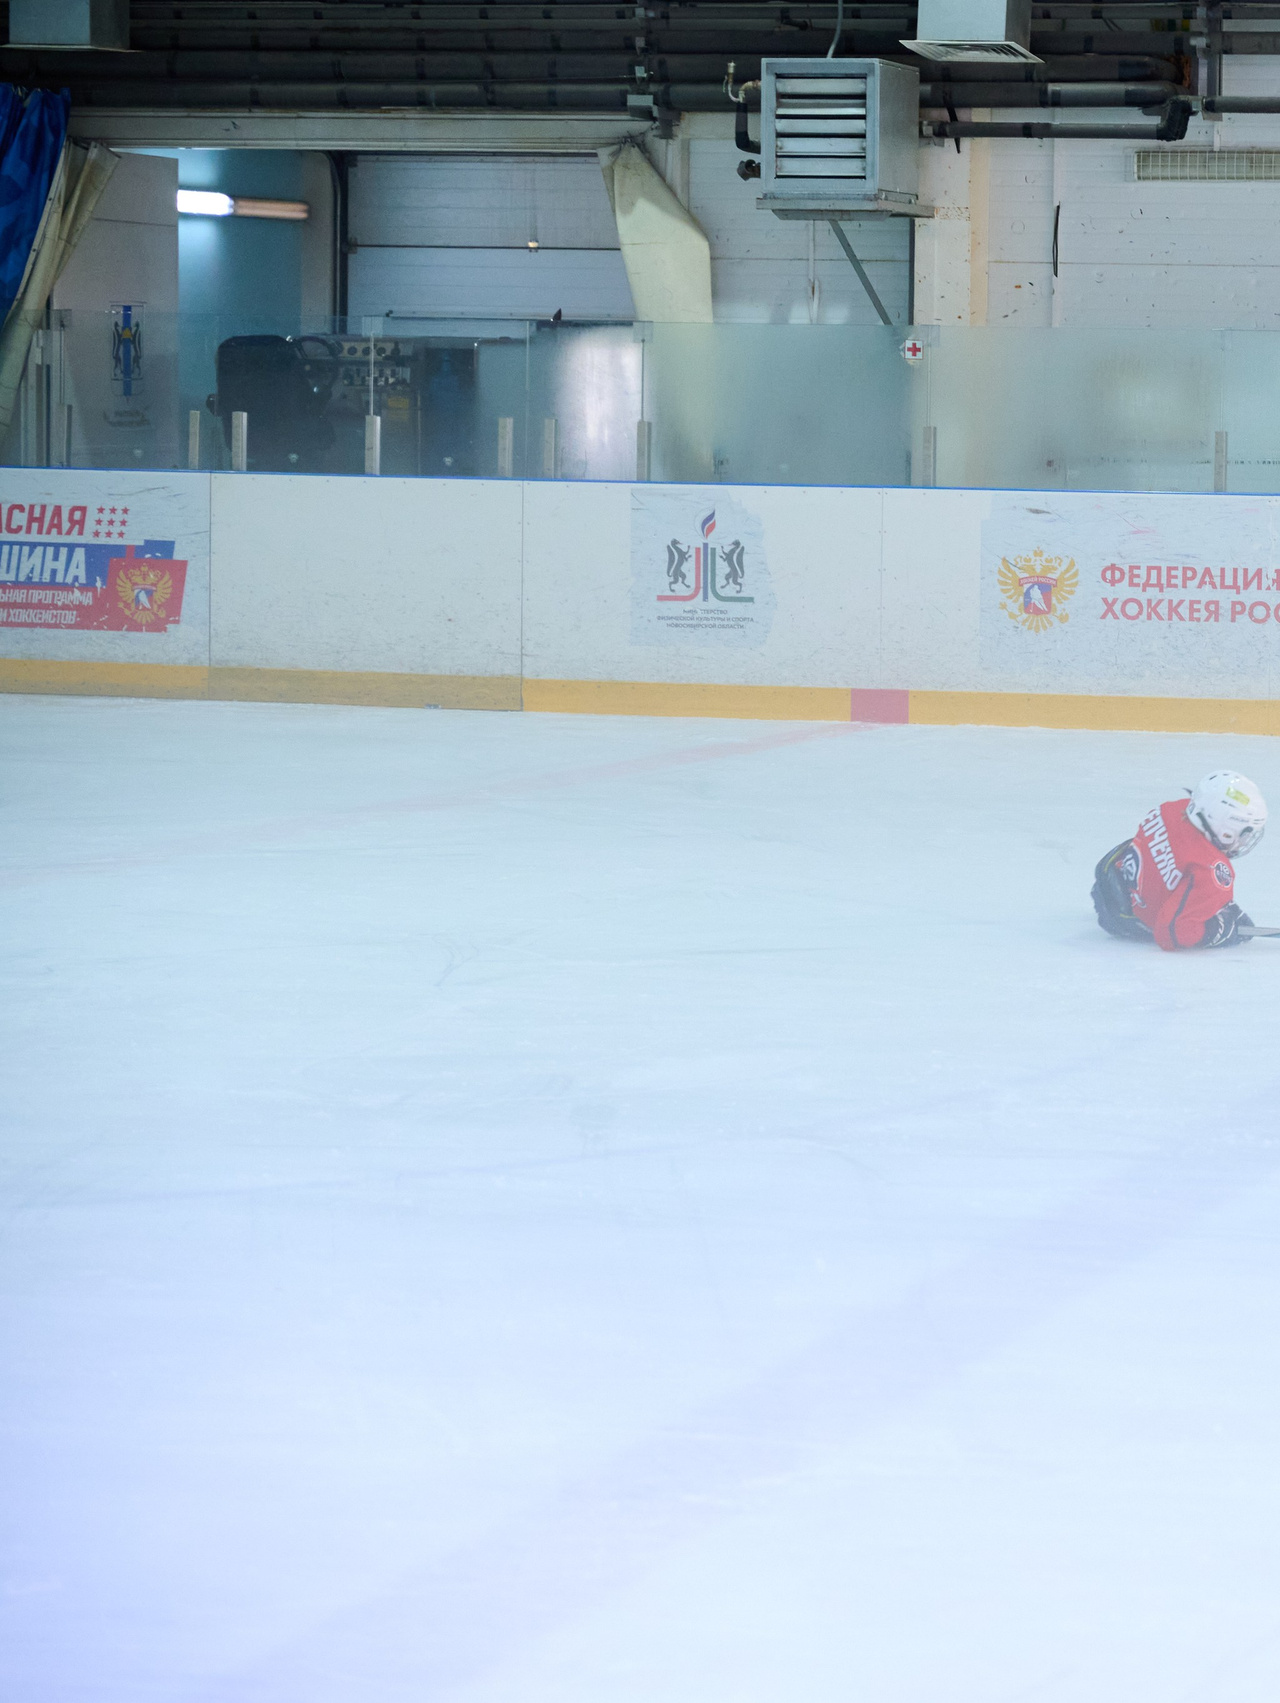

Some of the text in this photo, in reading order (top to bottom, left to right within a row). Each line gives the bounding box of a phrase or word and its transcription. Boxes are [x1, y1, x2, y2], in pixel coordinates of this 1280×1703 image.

[0, 503, 87, 536] СНАЯ
[28, 589, 93, 606] ПРОГРАММА
[1100, 597, 1220, 623] ХОККЕЯ
